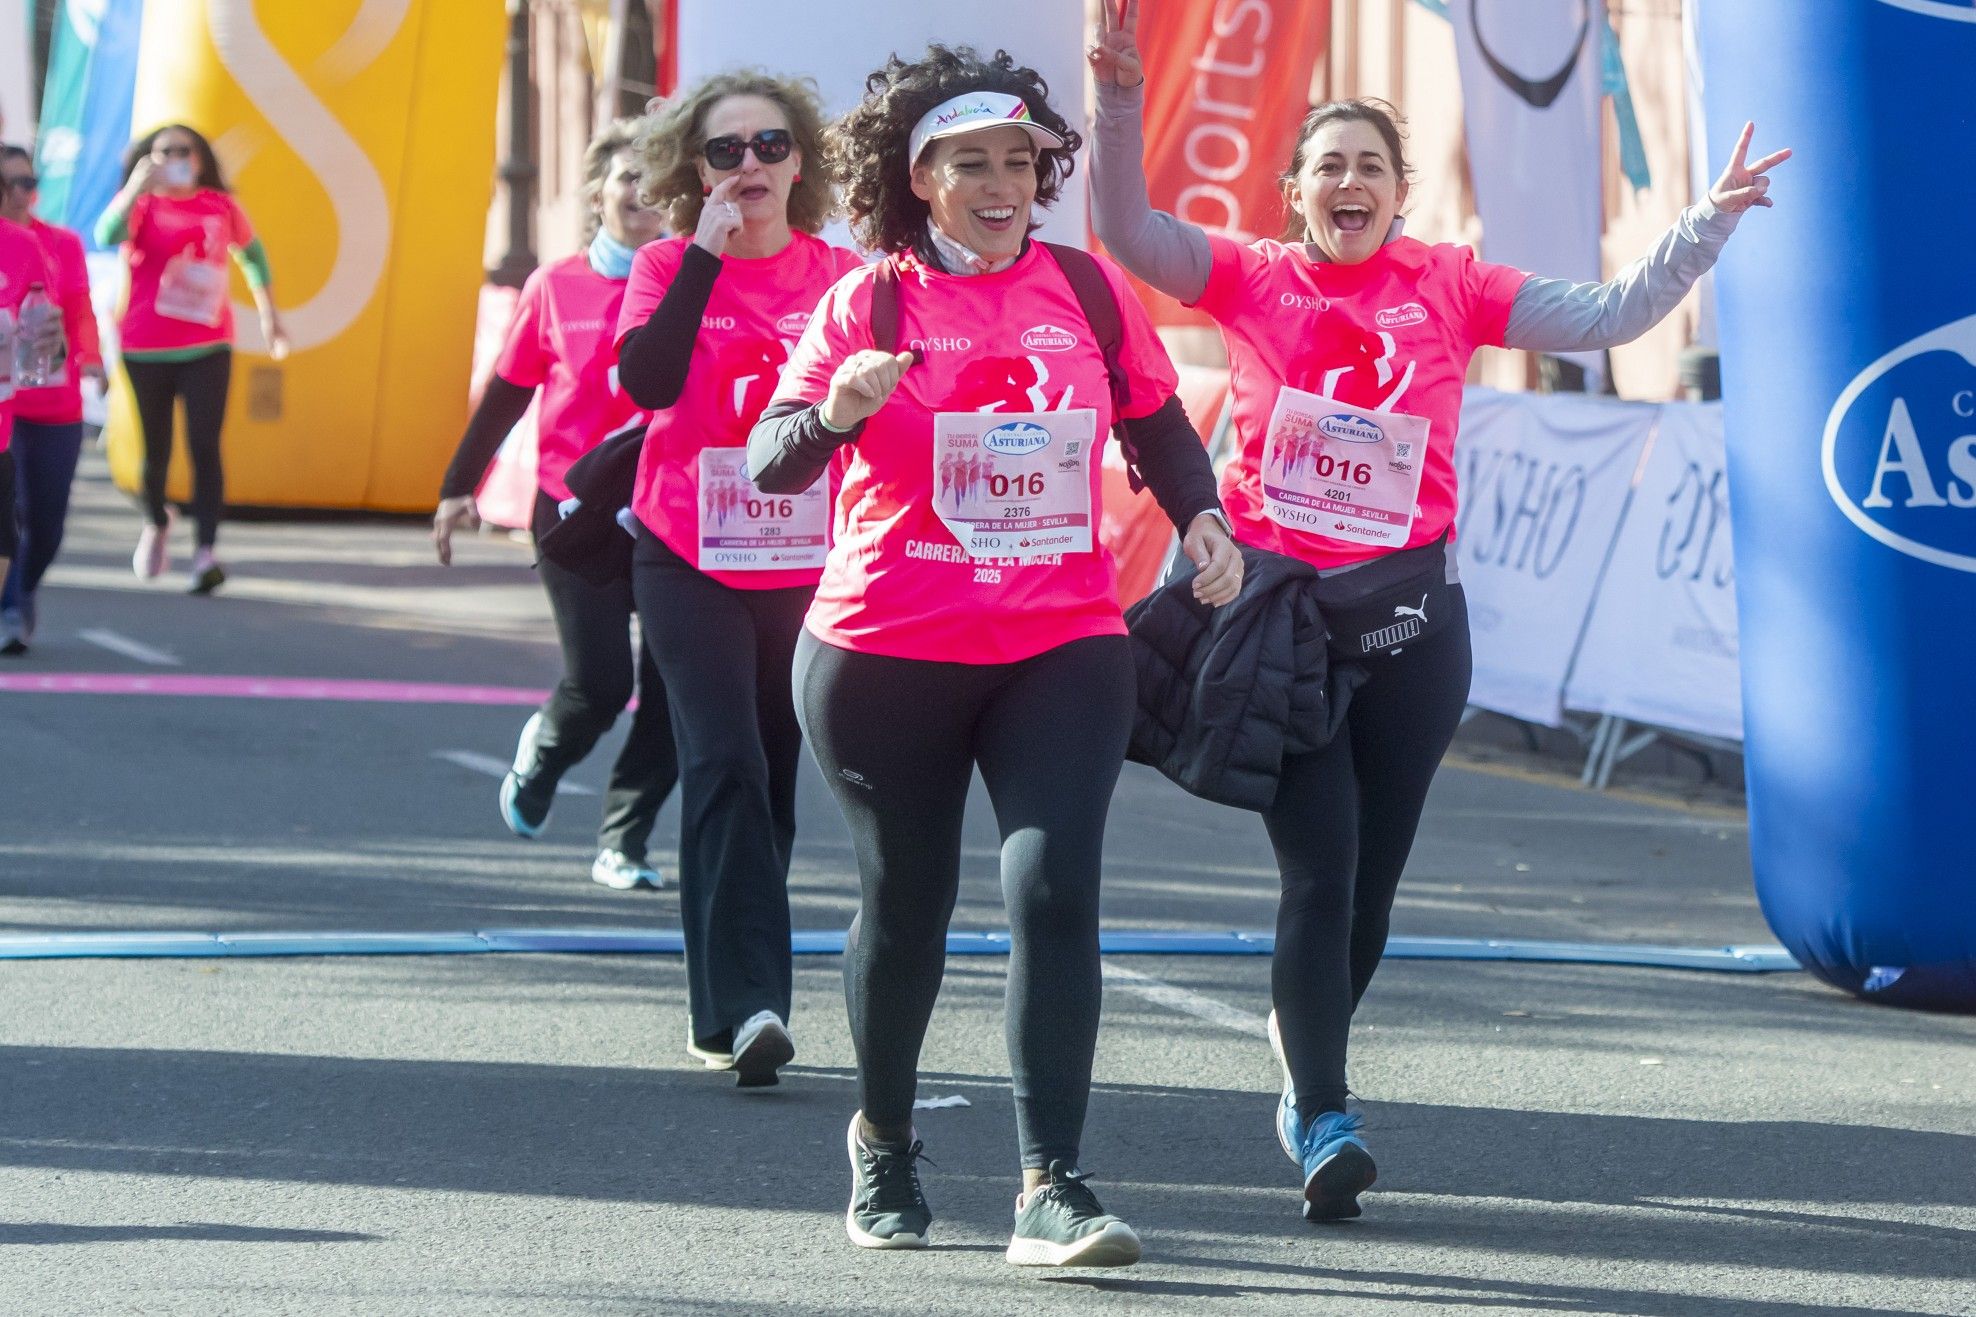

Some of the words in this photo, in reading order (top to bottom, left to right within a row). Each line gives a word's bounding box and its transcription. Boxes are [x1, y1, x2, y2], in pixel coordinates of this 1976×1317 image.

[1281, 292, 1331, 312] OYSHO
[701, 316, 736, 330] SHO
[910, 337, 971, 352] OYSHO
[1026, 334, 1074, 346] ASTURIANA
[1284, 414, 1313, 427] SUMA
[1322, 420, 1379, 440] ASTURIANA
[948, 439, 979, 448] SUMA
[989, 434, 1046, 447] ASTURIANA
[1315, 455, 1372, 485] 016
[989, 472, 1044, 497] 016
[1324, 488, 1351, 502] 4201
[746, 499, 793, 518] 016
[1004, 506, 1031, 518] 2376
[1279, 491, 1310, 505] CARRERA
[1311, 499, 1320, 508] DE
[1322, 501, 1331, 510] LA
[1333, 503, 1356, 515] MUJER
[1361, 509, 1389, 521] SEVILLA
[1273, 505, 1317, 525] OYSHO
[992, 521, 1001, 529] DE
[1015, 520, 1037, 529] MUJER
[1042, 517, 1068, 527] SEVILLA
[759, 527, 781, 536] 1283
[1346, 524, 1391, 539] Santander
[970, 537, 1001, 549] SHO
[1031, 535, 1073, 547] Santander
[715, 552, 757, 563] OYSHO
[781, 553, 814, 561] Santander
[905, 539, 970, 565] CARRERA
[973, 568, 1002, 584] 2025
[1361, 618, 1419, 653] PUMA
